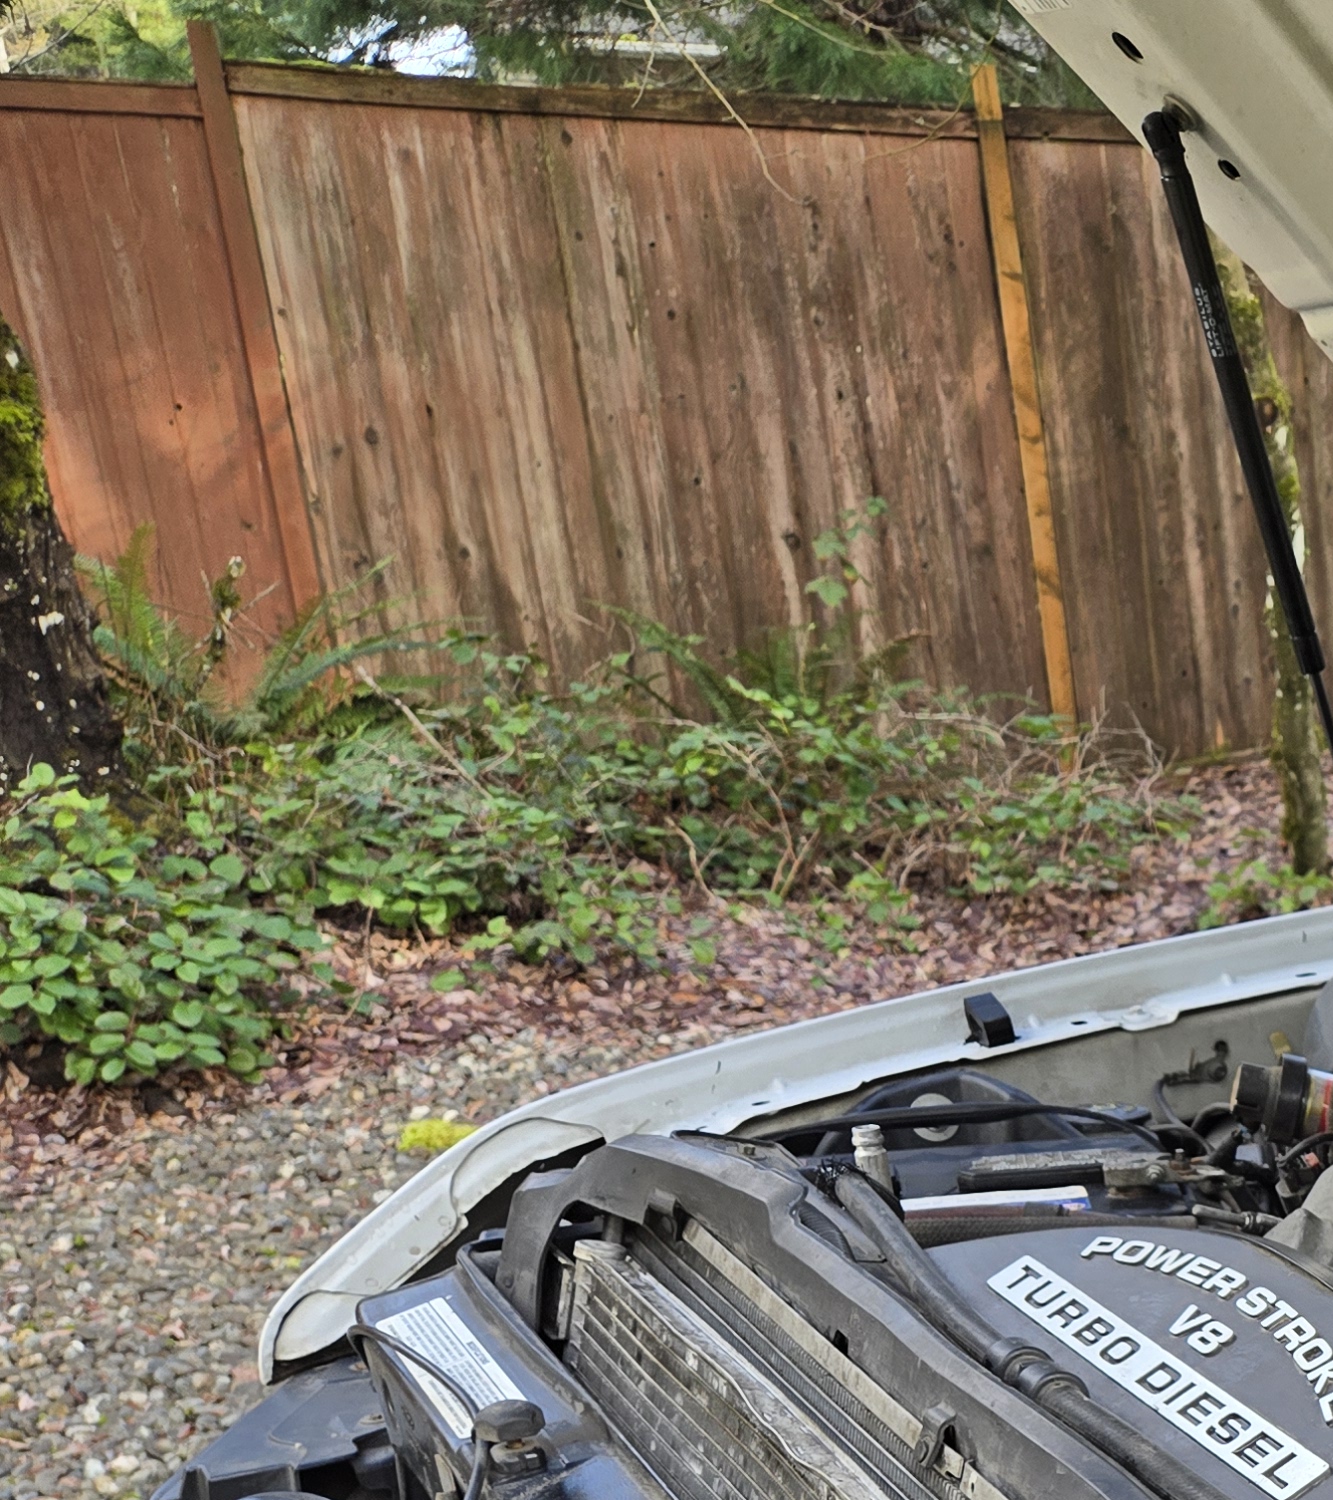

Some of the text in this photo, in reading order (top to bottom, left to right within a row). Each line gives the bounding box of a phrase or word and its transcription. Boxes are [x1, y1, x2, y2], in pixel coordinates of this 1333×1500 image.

[1081, 1235, 1248, 1299] POWER
[1169, 1304, 1235, 1356] V8
[1007, 1264, 1298, 1490] TURBO DIESEL
